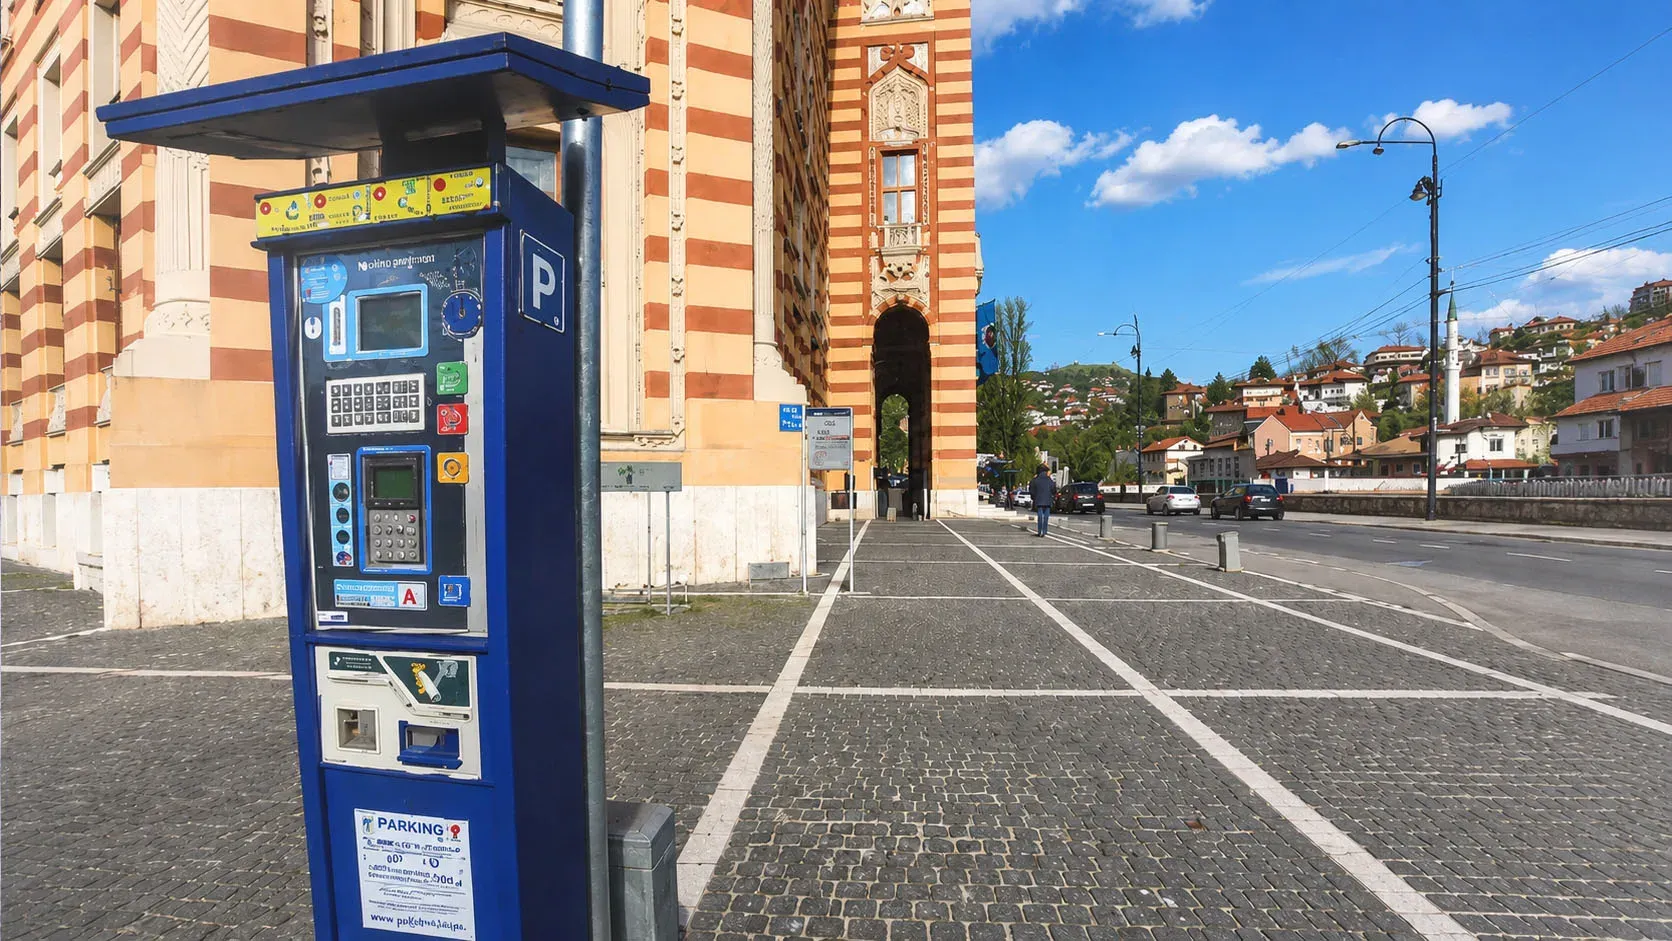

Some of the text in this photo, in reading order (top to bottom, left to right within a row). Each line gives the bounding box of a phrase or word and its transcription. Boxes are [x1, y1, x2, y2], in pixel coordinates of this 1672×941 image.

[533, 253, 556, 310] P
[402, 588, 417, 605] A
[377, 817, 444, 836] PARKING
